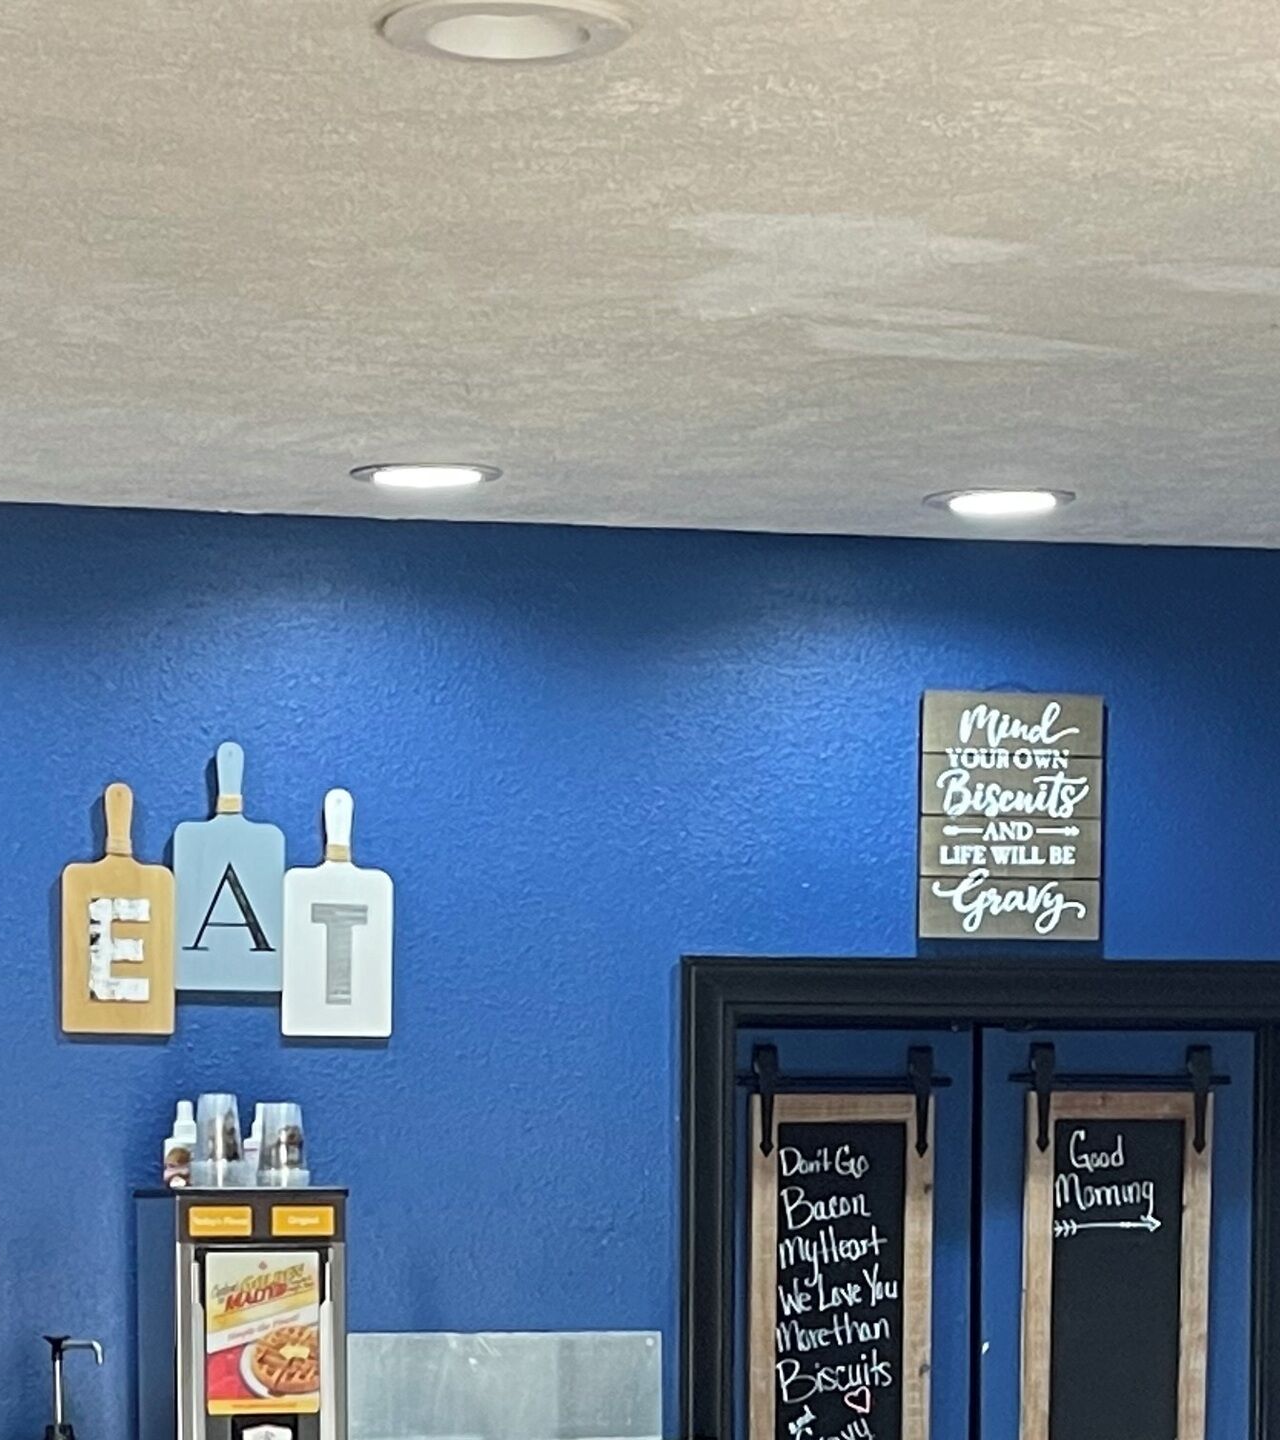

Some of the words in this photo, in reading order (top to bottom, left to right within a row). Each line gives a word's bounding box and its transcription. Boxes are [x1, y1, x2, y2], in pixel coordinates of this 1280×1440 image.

[959, 701, 1080, 748] Mind
[945, 747, 1010, 769] YOUR
[1012, 748, 1070, 769] OWN
[936, 767, 1090, 819] Biscuits
[982, 821, 1034, 842] AND
[939, 845, 987, 865] LIFE
[990, 845, 1046, 865] WILL
[1049, 846, 1076, 865] BE
[931, 867, 1087, 934] Gravy
[779, 1147, 832, 1177] Don't
[834, 1144, 870, 1179] Go
[1070, 1130, 1124, 1172] Good
[780, 1186, 871, 1230] Bacon
[1055, 1173, 1154, 1217] Morning
[819, 1225, 888, 1264] Heart
[778, 1278, 812, 1316] We
[818, 1273, 862, 1311] Love
[862, 1263, 898, 1307] You
[776, 1348, 892, 1403] Biscuits
